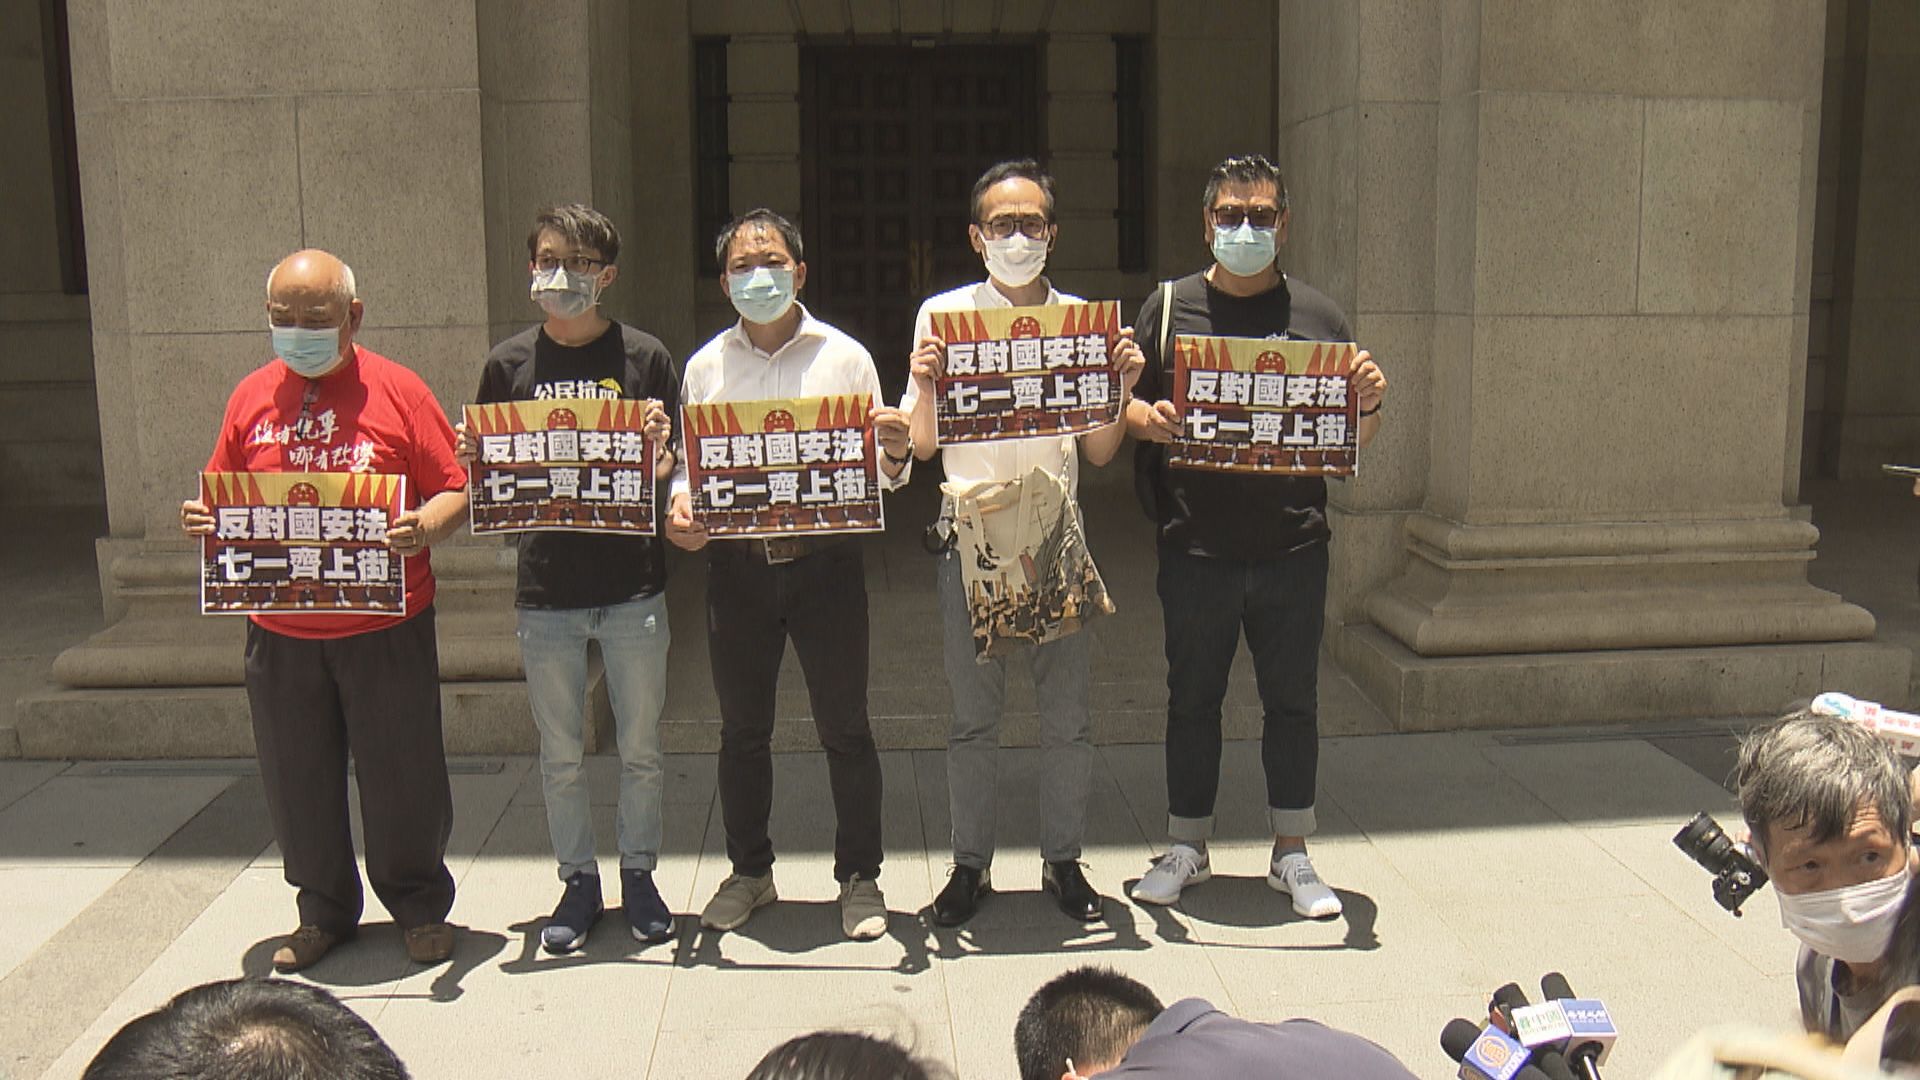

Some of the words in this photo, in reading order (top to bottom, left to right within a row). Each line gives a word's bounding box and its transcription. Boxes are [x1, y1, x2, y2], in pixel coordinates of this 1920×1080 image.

[947, 334, 1108, 375] 反對國安法
[947, 372, 1109, 413] 七一齊上街
[1187, 371, 1347, 407] 反對國安法
[1186, 408, 1346, 445] 七一齊上街
[482, 431, 643, 464] 反對國安法
[700, 428, 864, 469] 反對國安法
[484, 468, 642, 501] 七一齊上街
[702, 468, 866, 507] 七一齊上街
[218, 506, 388, 541] 反對國安法
[218, 547, 389, 582] 七一齊上街
